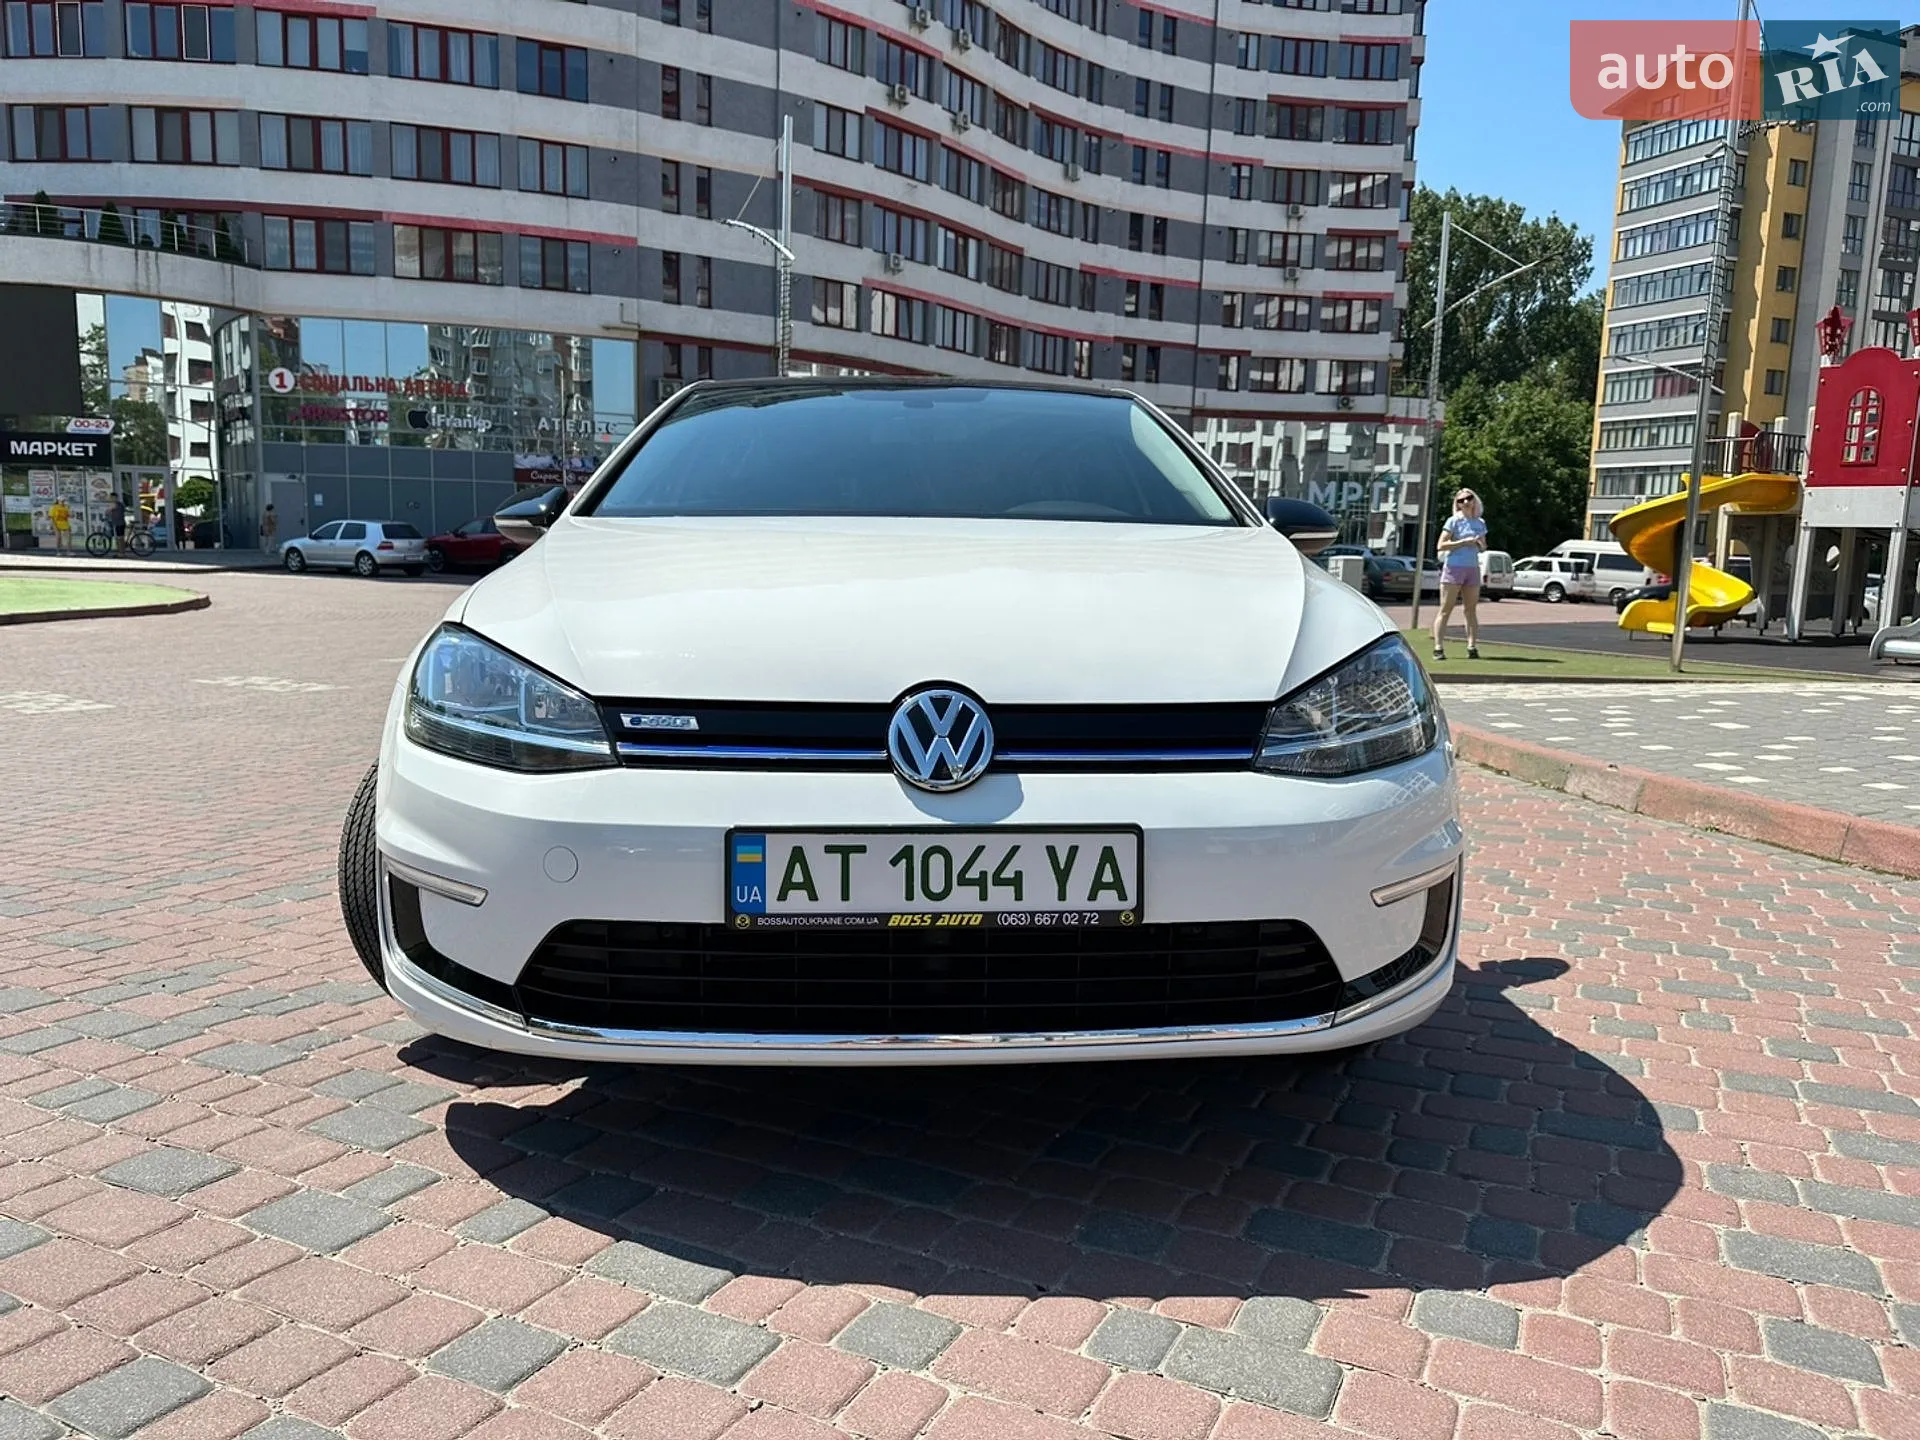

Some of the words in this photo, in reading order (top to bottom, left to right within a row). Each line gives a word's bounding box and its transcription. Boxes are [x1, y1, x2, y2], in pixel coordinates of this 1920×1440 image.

[275, 371, 288, 389] 1
[10, 440, 97, 457] МАРКЕТ
[776, 844, 867, 902] AT
[889, 844, 1023, 902] 1044
[1045, 844, 1128, 902] YA
[736, 886, 762, 903] UA
[888, 914, 931, 927] BOSS
[936, 913, 984, 926] AUTO
[997, 913, 1031, 926] (063)
[1034, 913, 1057, 926] 667
[1062, 912, 1079, 925] 02
[1082, 912, 1100, 925] 72
